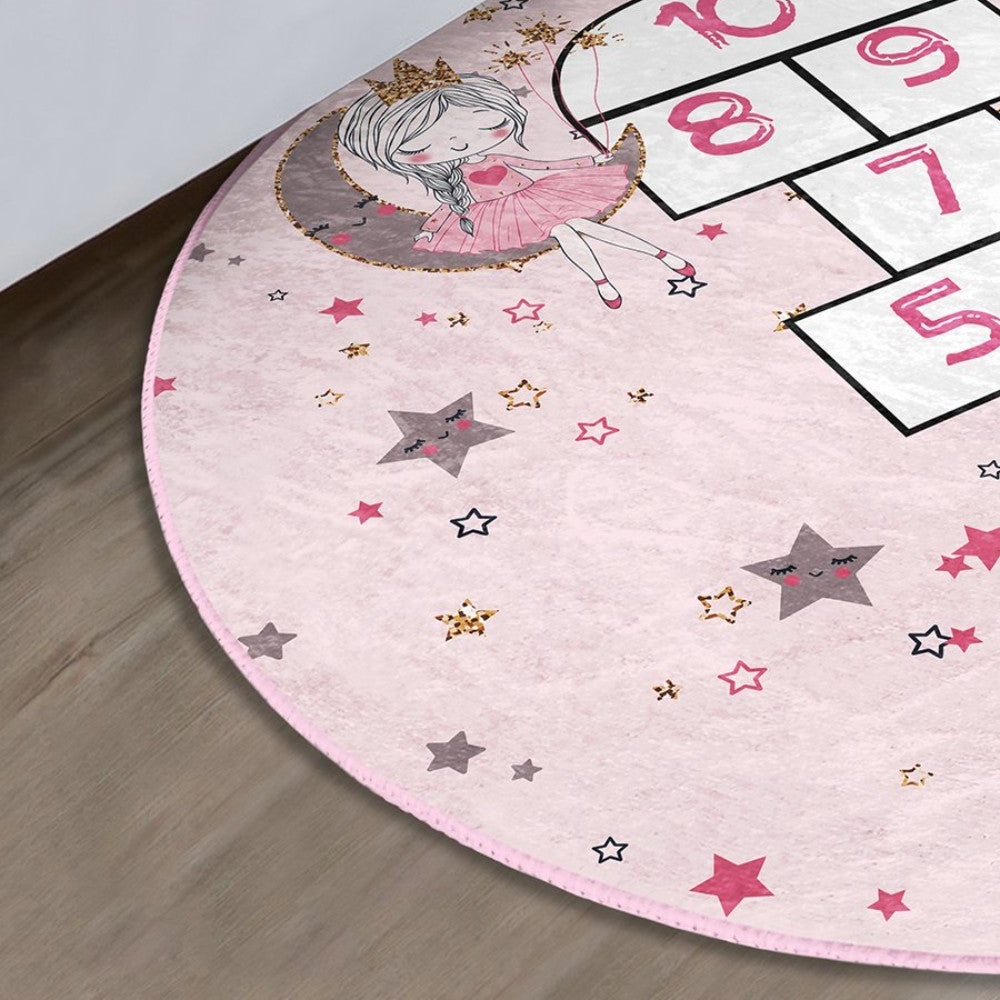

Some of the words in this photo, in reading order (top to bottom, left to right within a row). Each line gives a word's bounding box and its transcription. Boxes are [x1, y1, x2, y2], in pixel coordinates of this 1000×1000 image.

[857, 27, 960, 88] 9
[668, 92, 775, 156] 8
[866, 144, 961, 215] 7
